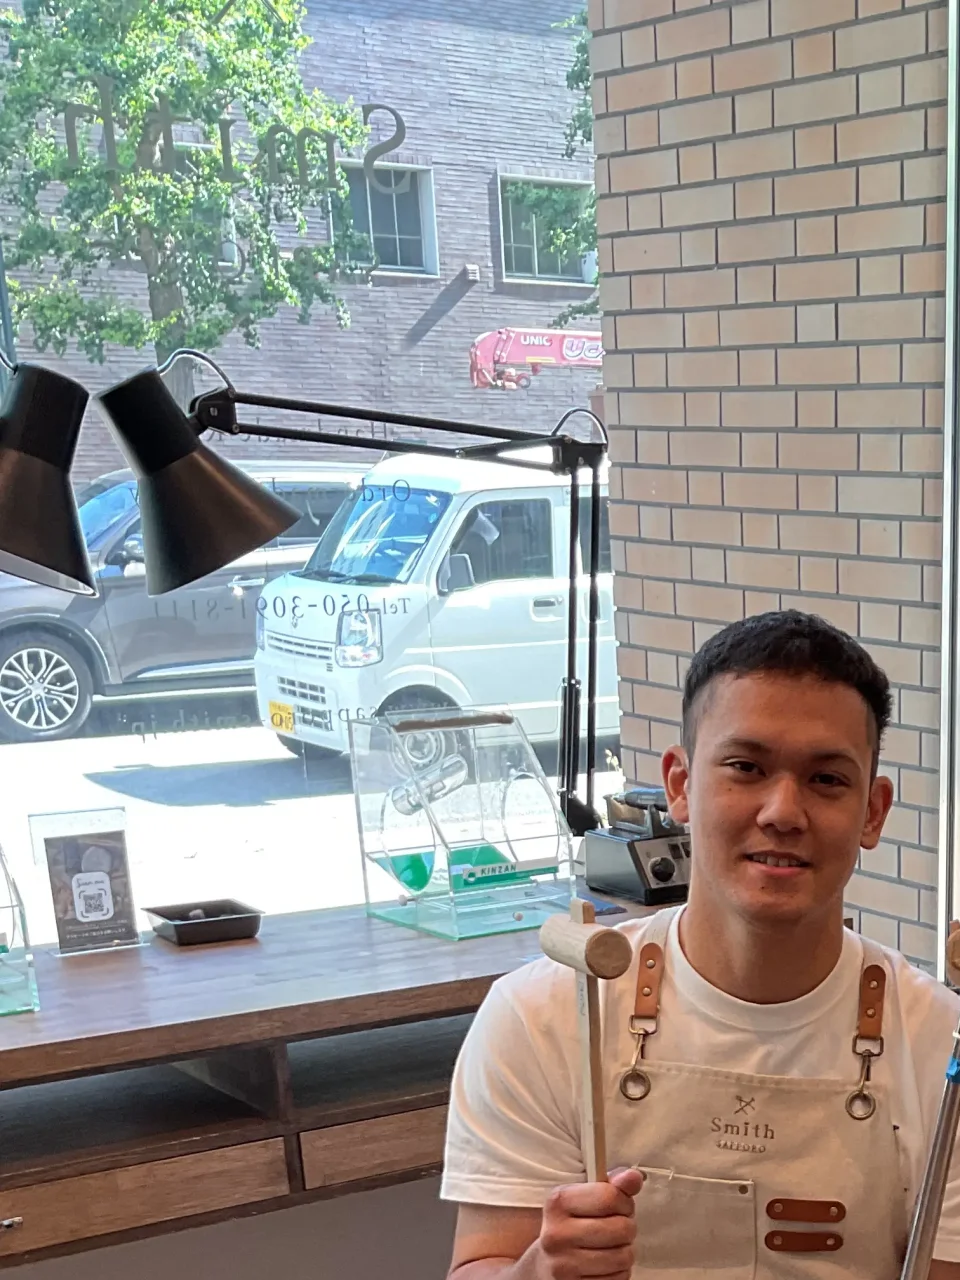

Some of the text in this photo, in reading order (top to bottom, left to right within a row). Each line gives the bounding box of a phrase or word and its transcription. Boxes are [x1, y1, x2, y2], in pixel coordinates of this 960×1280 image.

[520, 335, 552, 346] UNIC
[480, 863, 517, 876] KINZAN
[711, 1116, 775, 1140] Smith
[716, 1140, 767, 1154] SAPPORO
